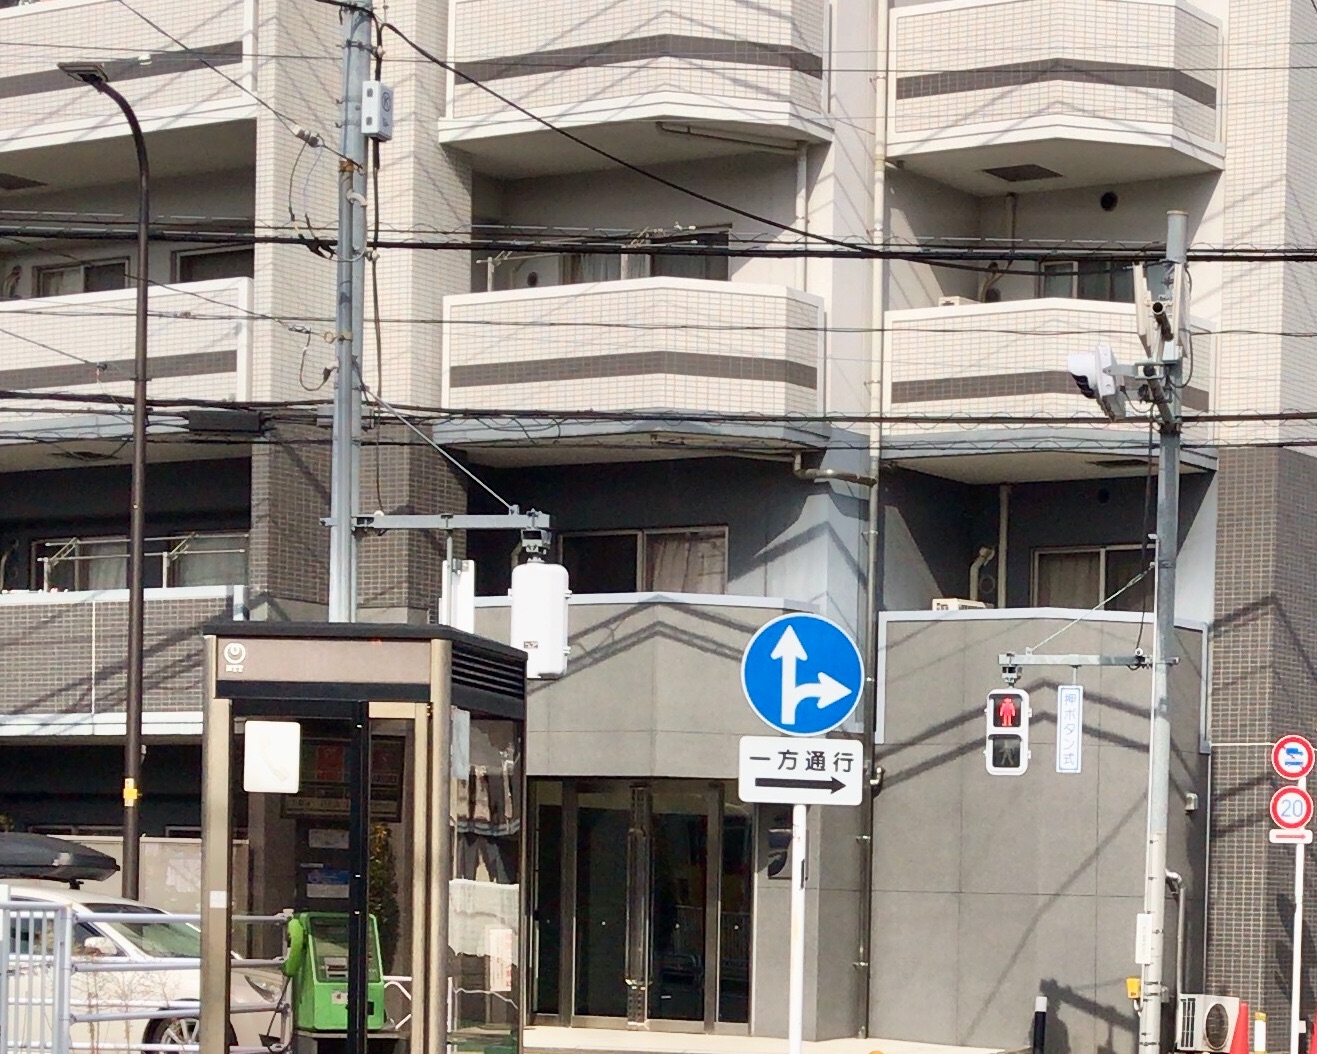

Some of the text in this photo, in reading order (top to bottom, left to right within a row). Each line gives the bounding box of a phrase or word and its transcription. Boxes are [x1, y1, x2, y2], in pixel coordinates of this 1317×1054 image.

[1063, 693, 1077, 765] 押ボタン式
[749, 749, 854, 772] 一方通行
[1281, 799, 1303, 817] 20
